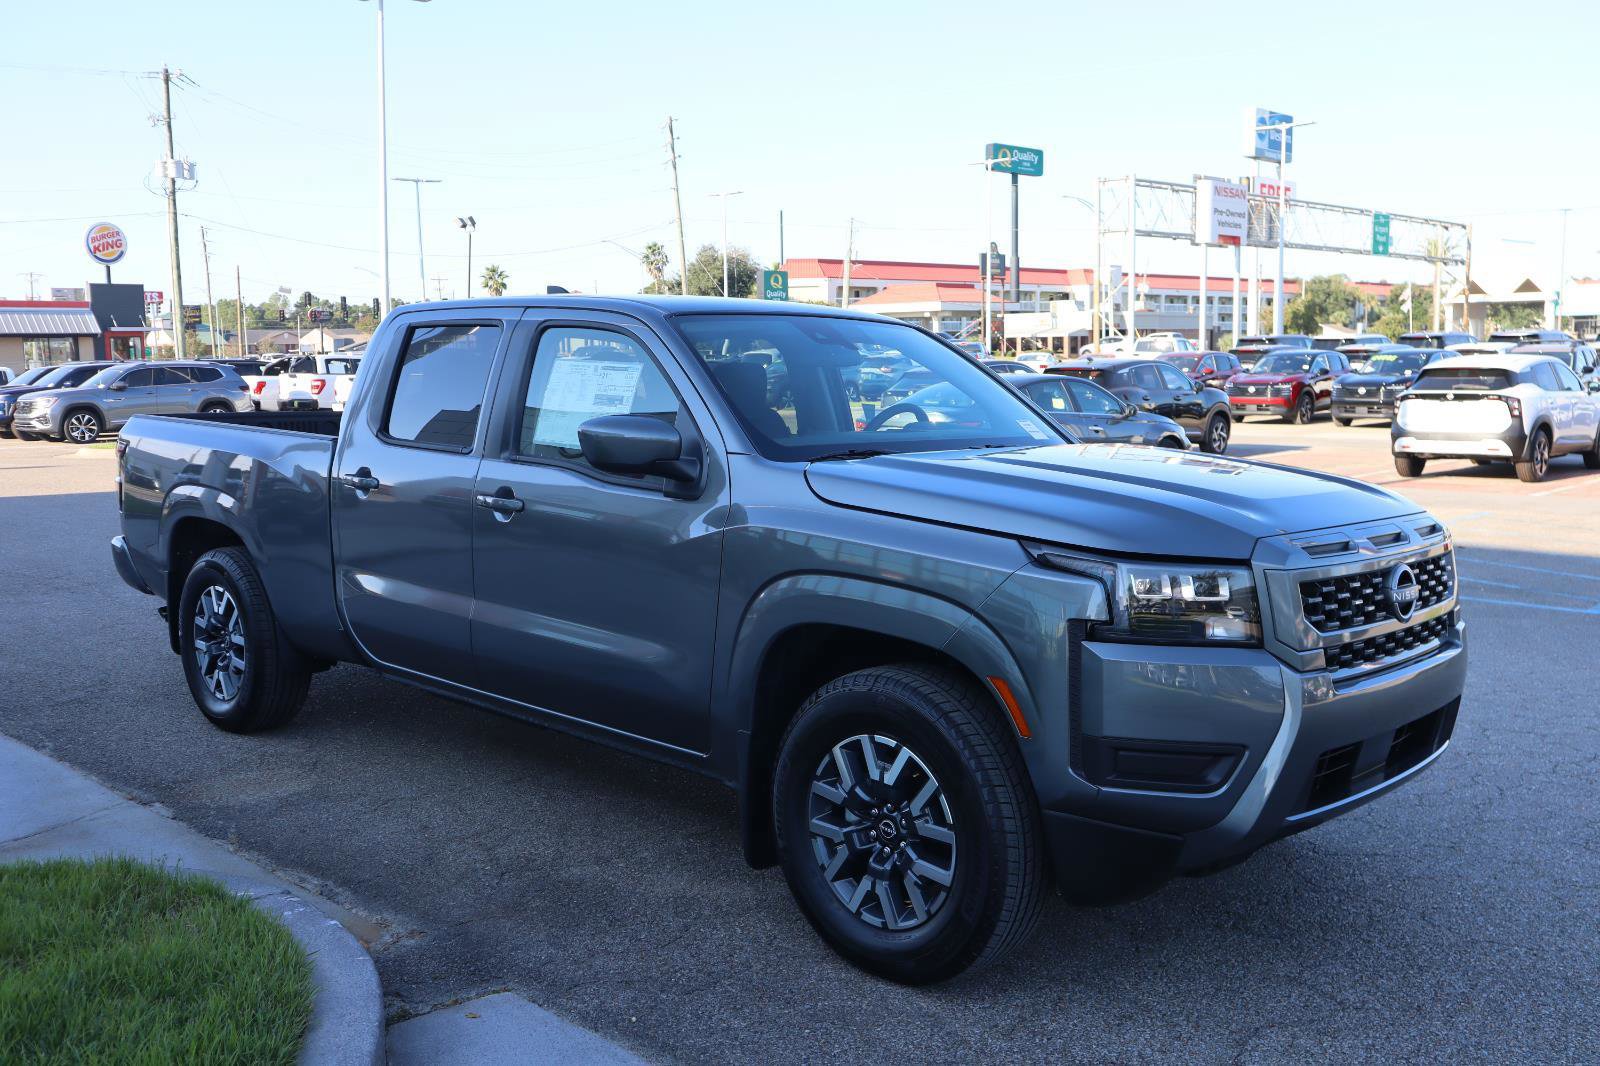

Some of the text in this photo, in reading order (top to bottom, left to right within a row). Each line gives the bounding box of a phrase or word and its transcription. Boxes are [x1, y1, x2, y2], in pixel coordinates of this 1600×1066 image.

[1012, 149, 1039, 165] Quality
[1214, 186, 1247, 200] NISSAN
[1213, 207, 1246, 219] Pre-Owned
[1216, 220, 1242, 229] Vehicles
[90, 230, 121, 244] BURGER
[93, 239, 123, 255] KING
[766, 290, 785, 299] Quality
